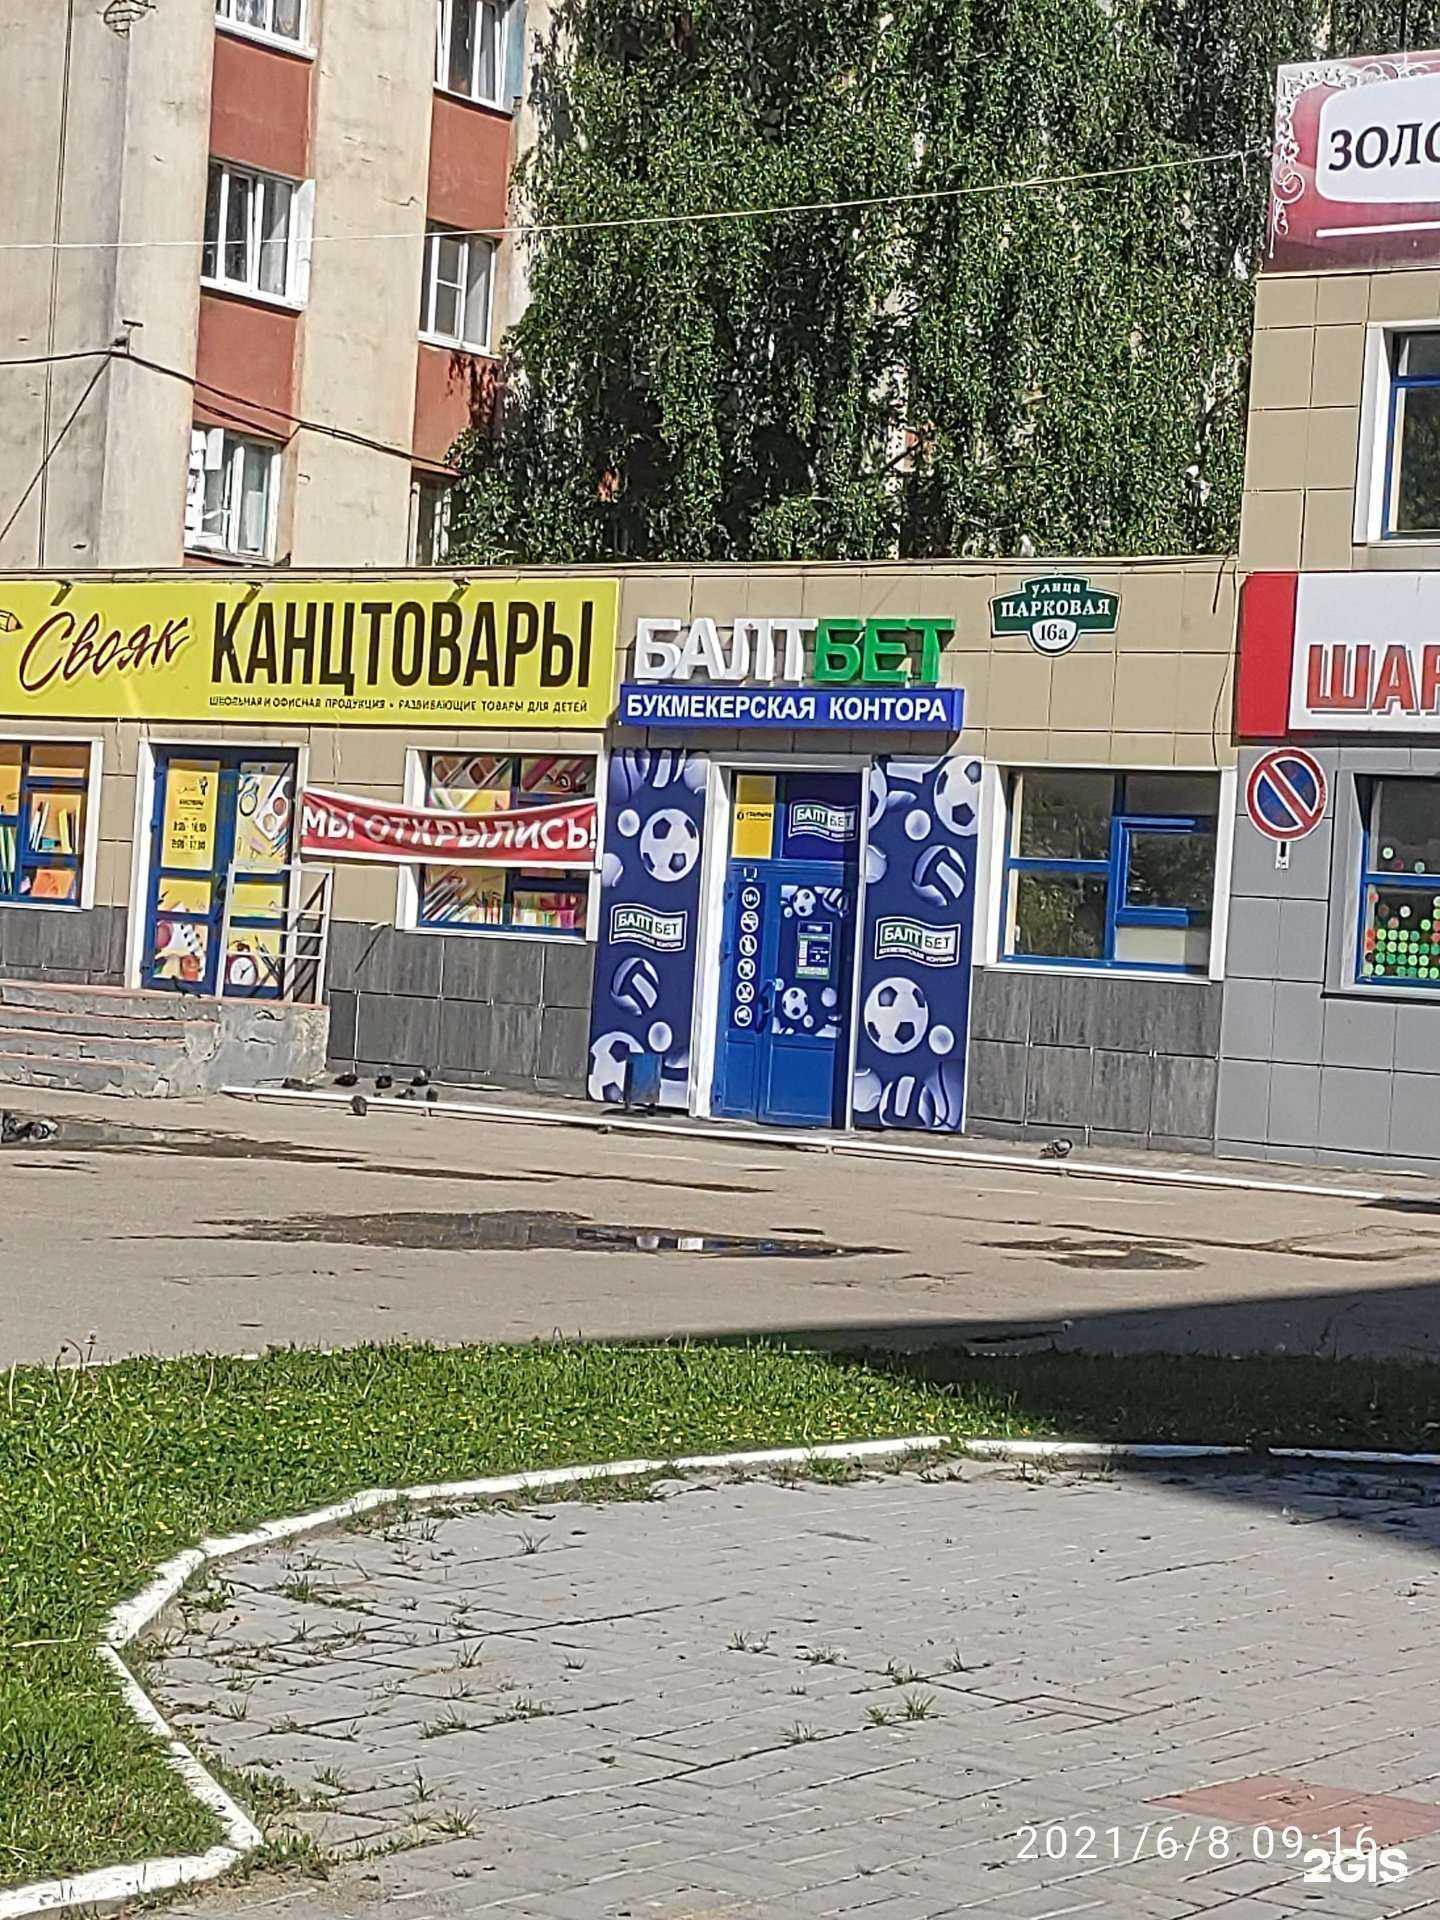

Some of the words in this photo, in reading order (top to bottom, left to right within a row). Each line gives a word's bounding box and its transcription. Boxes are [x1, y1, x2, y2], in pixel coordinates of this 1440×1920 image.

[1001, 599, 1111, 618] ПАРКОВАЯ
[1039, 624, 1068, 641] 16а
[19, 611, 190, 691] Свояк
[210, 601, 594, 695] КАНЦТОВАРЫ
[273, 697, 321, 708] ОФИСНАЯ
[325, 698, 386, 709] ПРОДУКЦИЯ
[399, 700, 476, 711] РАЗВИВАЮЩИЕ
[481, 700, 523, 711] ТОВАРЫ
[527, 701, 549, 712] ДЛЯ
[552, 700, 587, 712] ДЕТЕЙ
[626, 694, 815, 720] БУКМЕКЕРСКАЯ
[829, 697, 947, 722] КОНТОРА
[301, 806, 355, 839] МЫ
[364, 815, 597, 851] ОТКРЫЛИСЬ!
